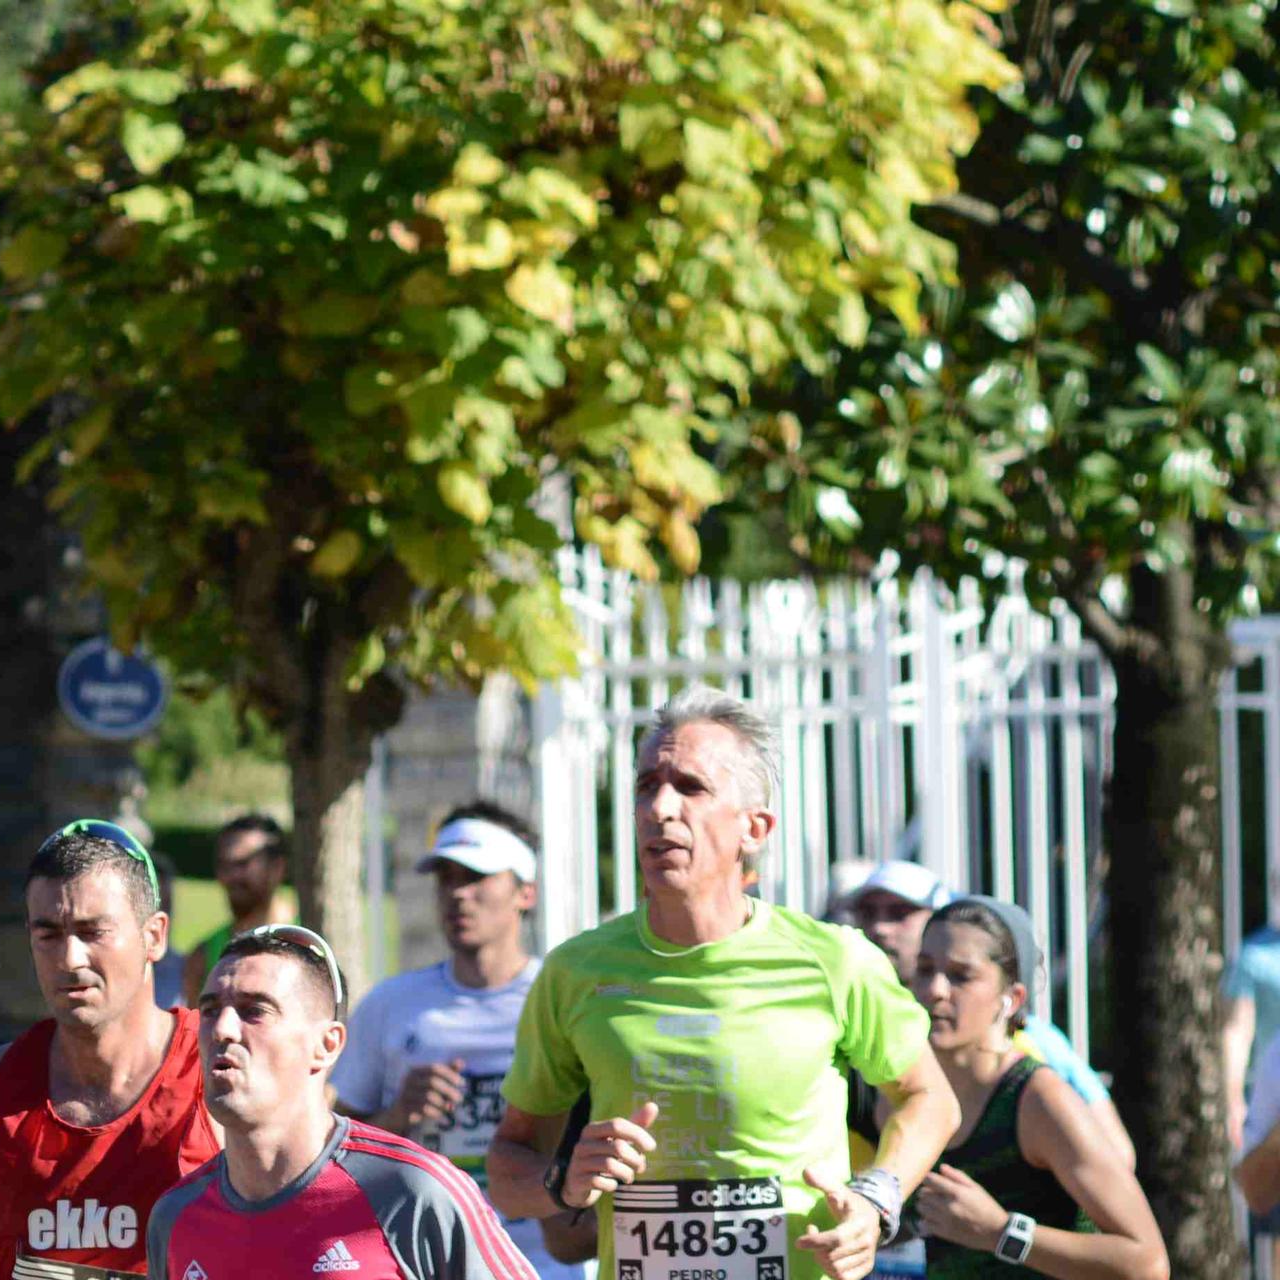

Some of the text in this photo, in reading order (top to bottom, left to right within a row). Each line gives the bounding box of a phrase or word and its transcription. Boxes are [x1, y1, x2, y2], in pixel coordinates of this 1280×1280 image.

[691, 1184, 777, 1206] adidas
[27, 1199, 138, 1249] ekke
[631, 1218, 768, 1257] 14853
[313, 1258, 360, 1273] adidas
